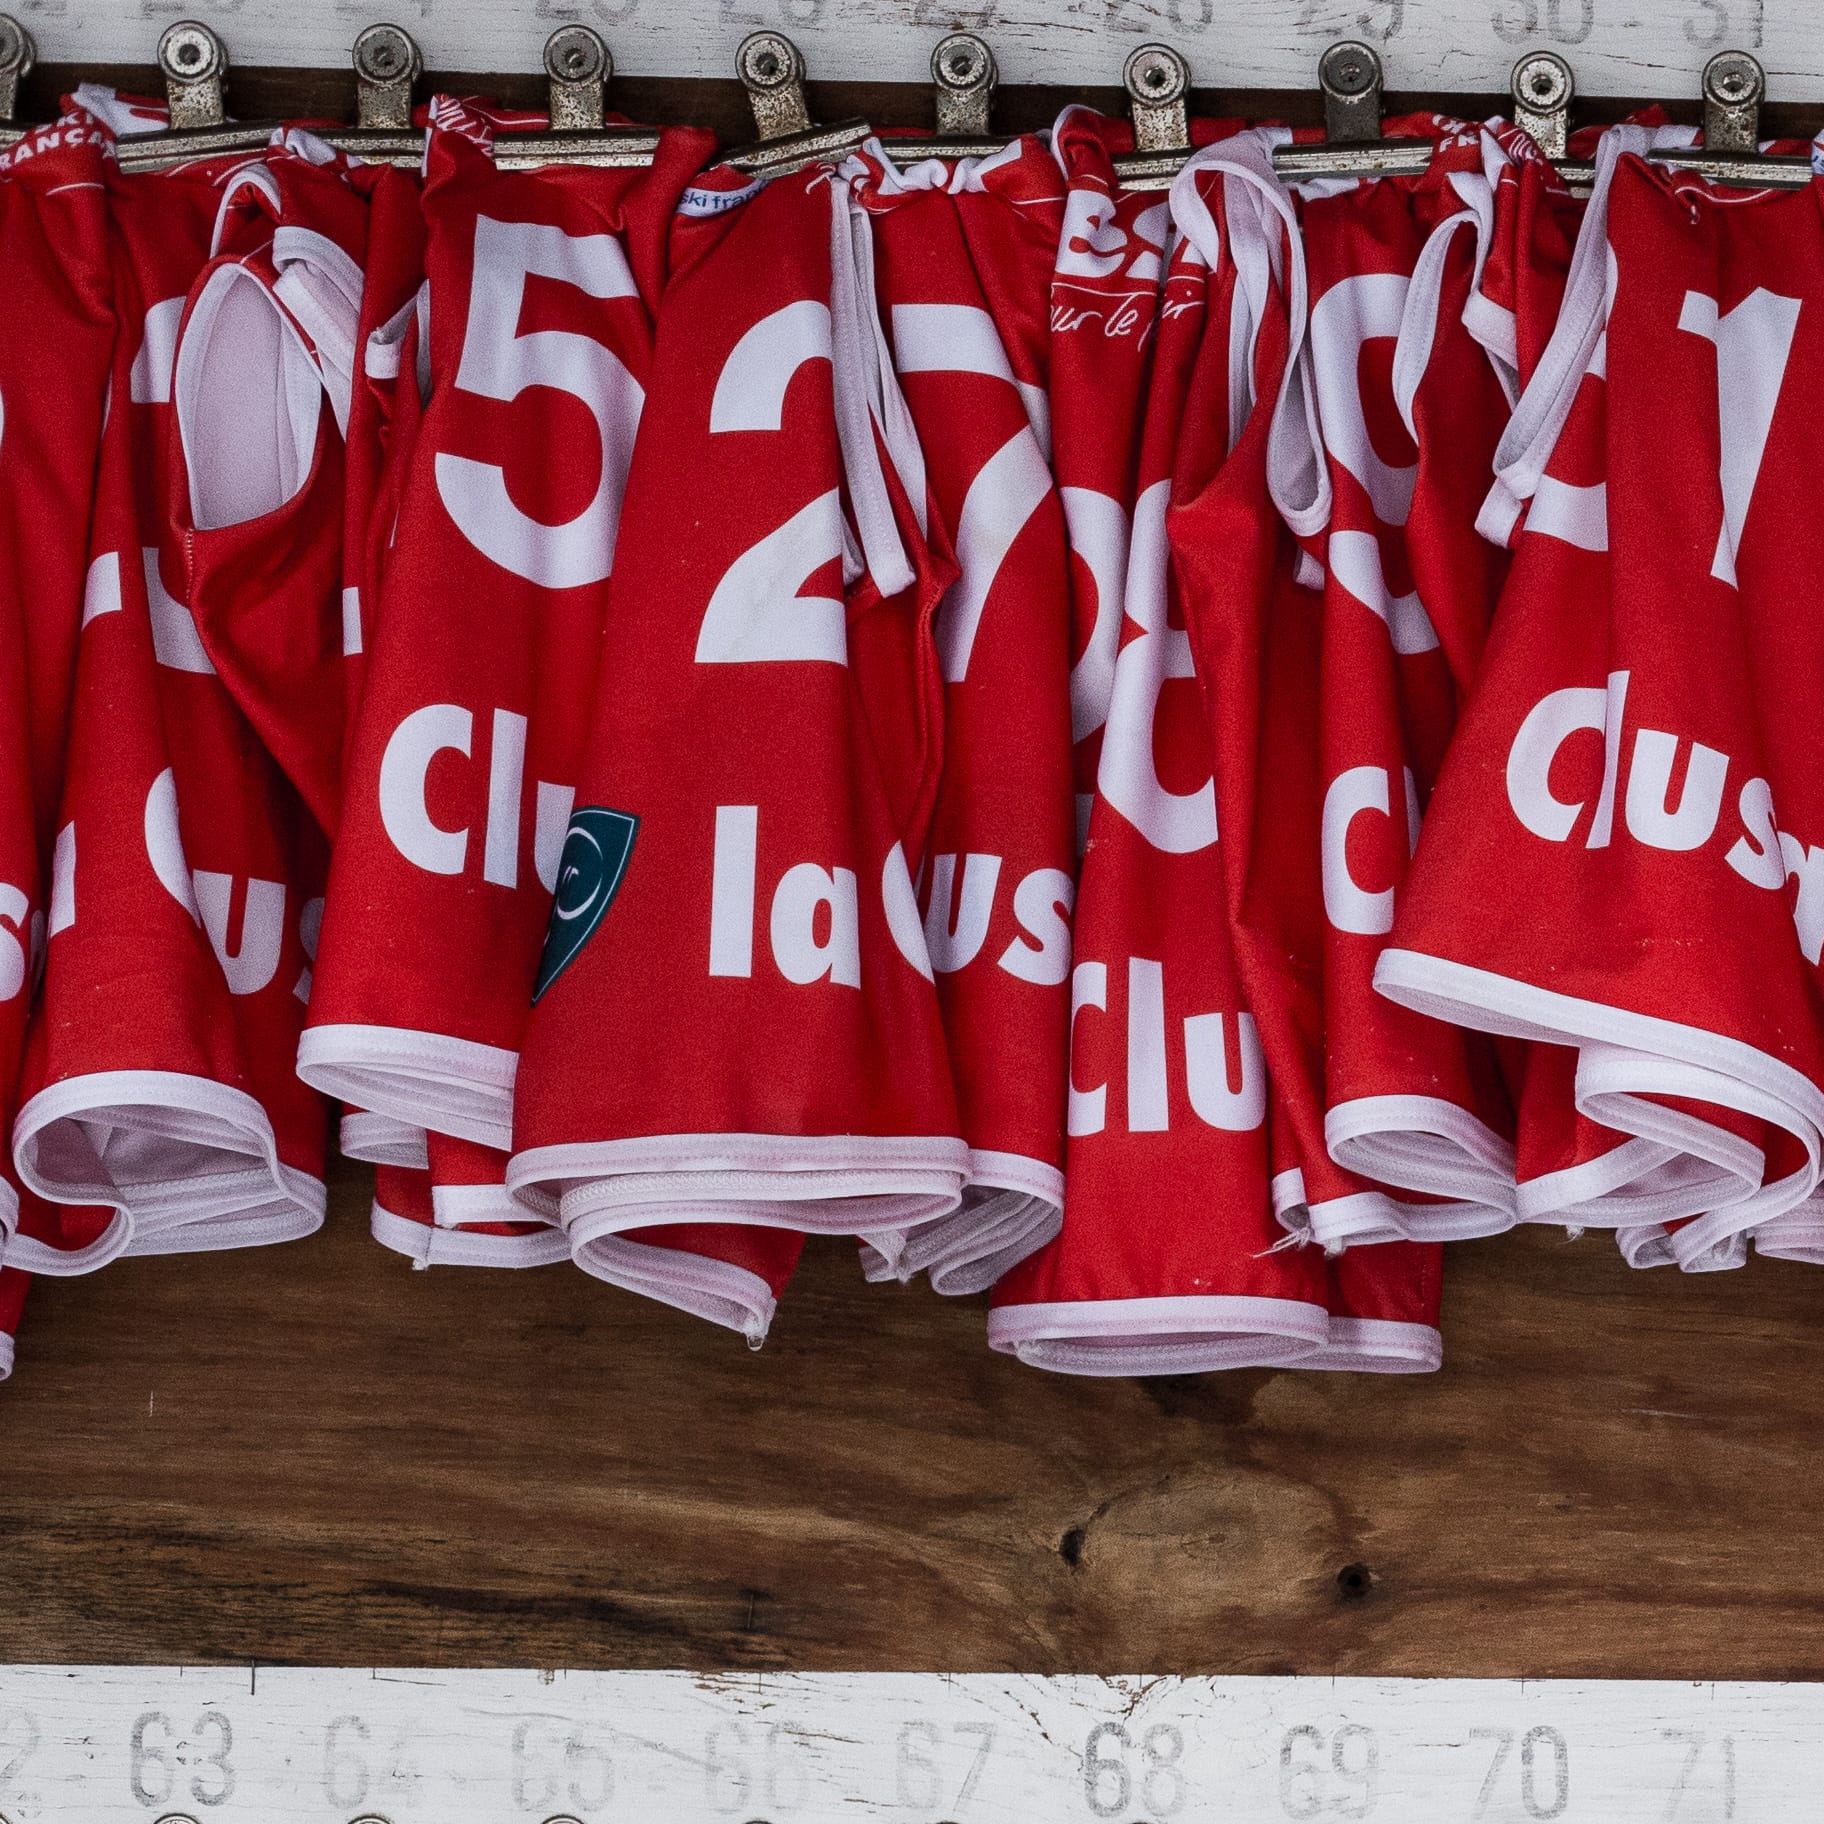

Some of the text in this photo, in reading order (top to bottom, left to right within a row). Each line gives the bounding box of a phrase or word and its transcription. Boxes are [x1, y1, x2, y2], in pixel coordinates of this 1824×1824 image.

[435, 213, 645, 590] 5
[708, 804, 861, 990] la
[130, 1710, 235, 1808] 63
[511, 1716, 616, 1813] 65
[704, 1718, 808, 1814] 66
[895, 1720, 1000, 1814] 67
[1083, 1721, 1187, 1818] 68
[1278, 1723, 1380, 1820] 69
[1468, 1724, 1570, 1821] 70
[1659, 1727, 1739, 1822] 71
